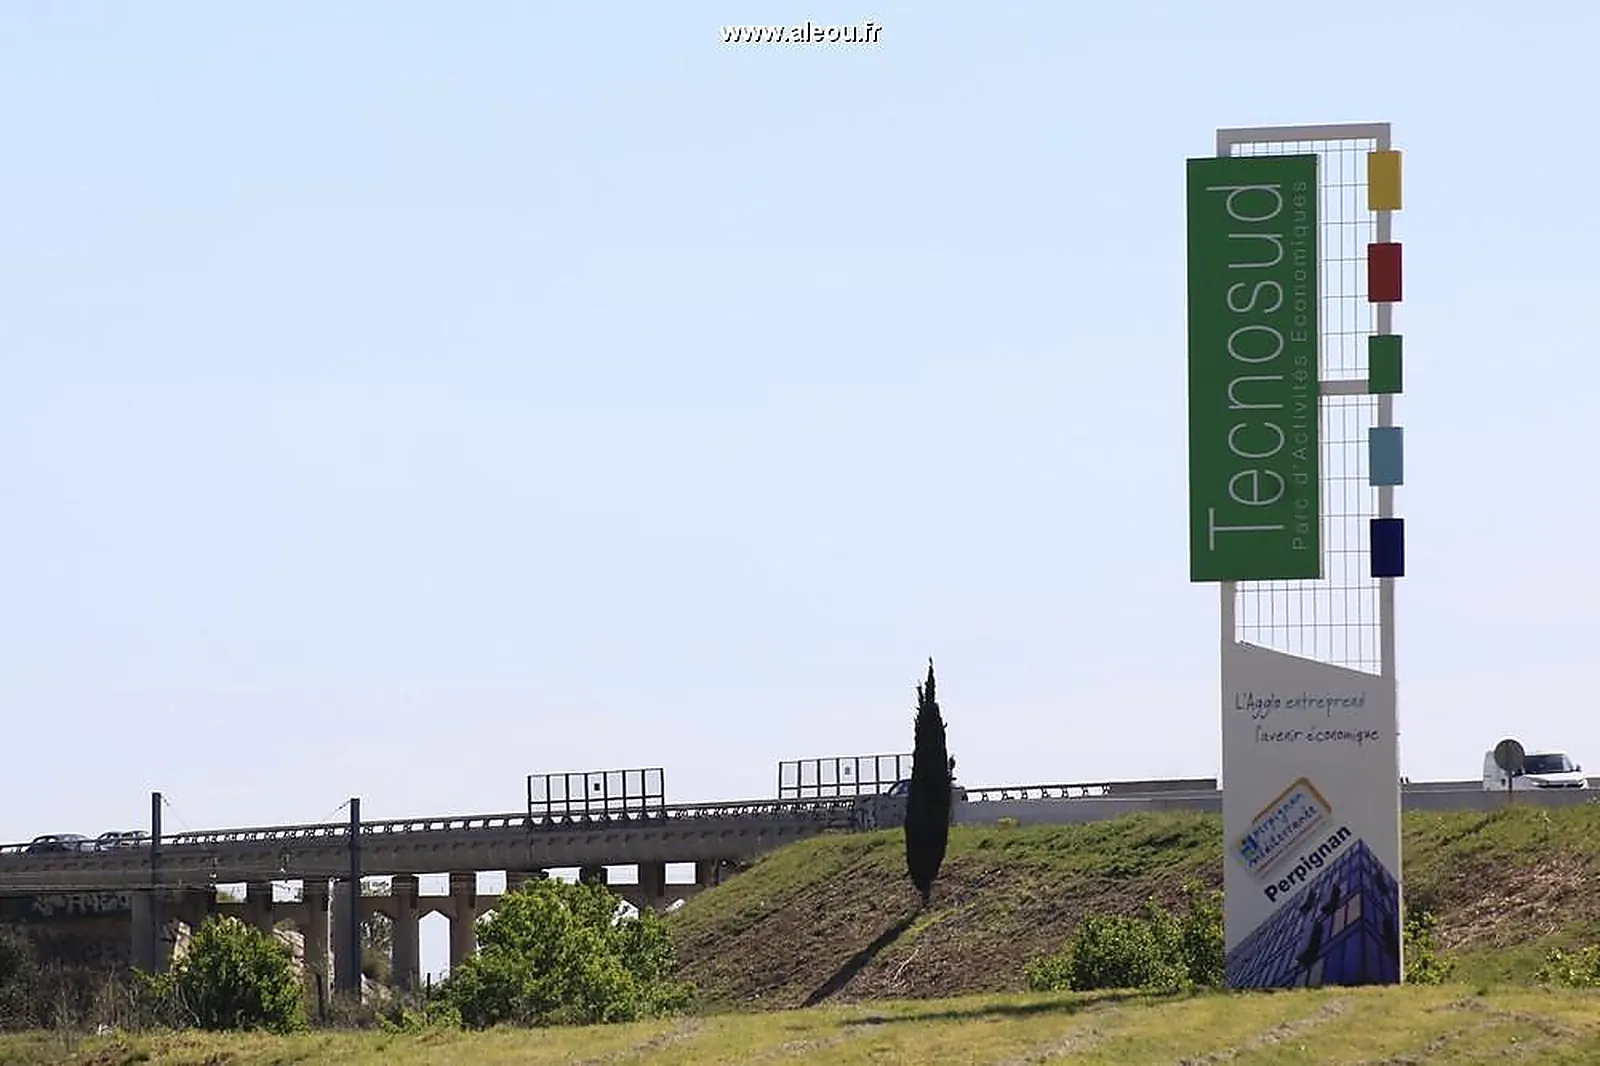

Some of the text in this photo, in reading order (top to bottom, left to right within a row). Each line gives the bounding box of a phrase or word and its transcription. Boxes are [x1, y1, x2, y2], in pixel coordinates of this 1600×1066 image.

[1205, 184, 1285, 551] Tecnosud
[1291, 356, 1309, 484] d'Activités
[1292, 499, 1309, 550] Parc
[1235, 691, 1365, 719] L'Agglo entreprend
[1305, 725, 1380, 747] économique
[1264, 826, 1352, 902] Perpignan
